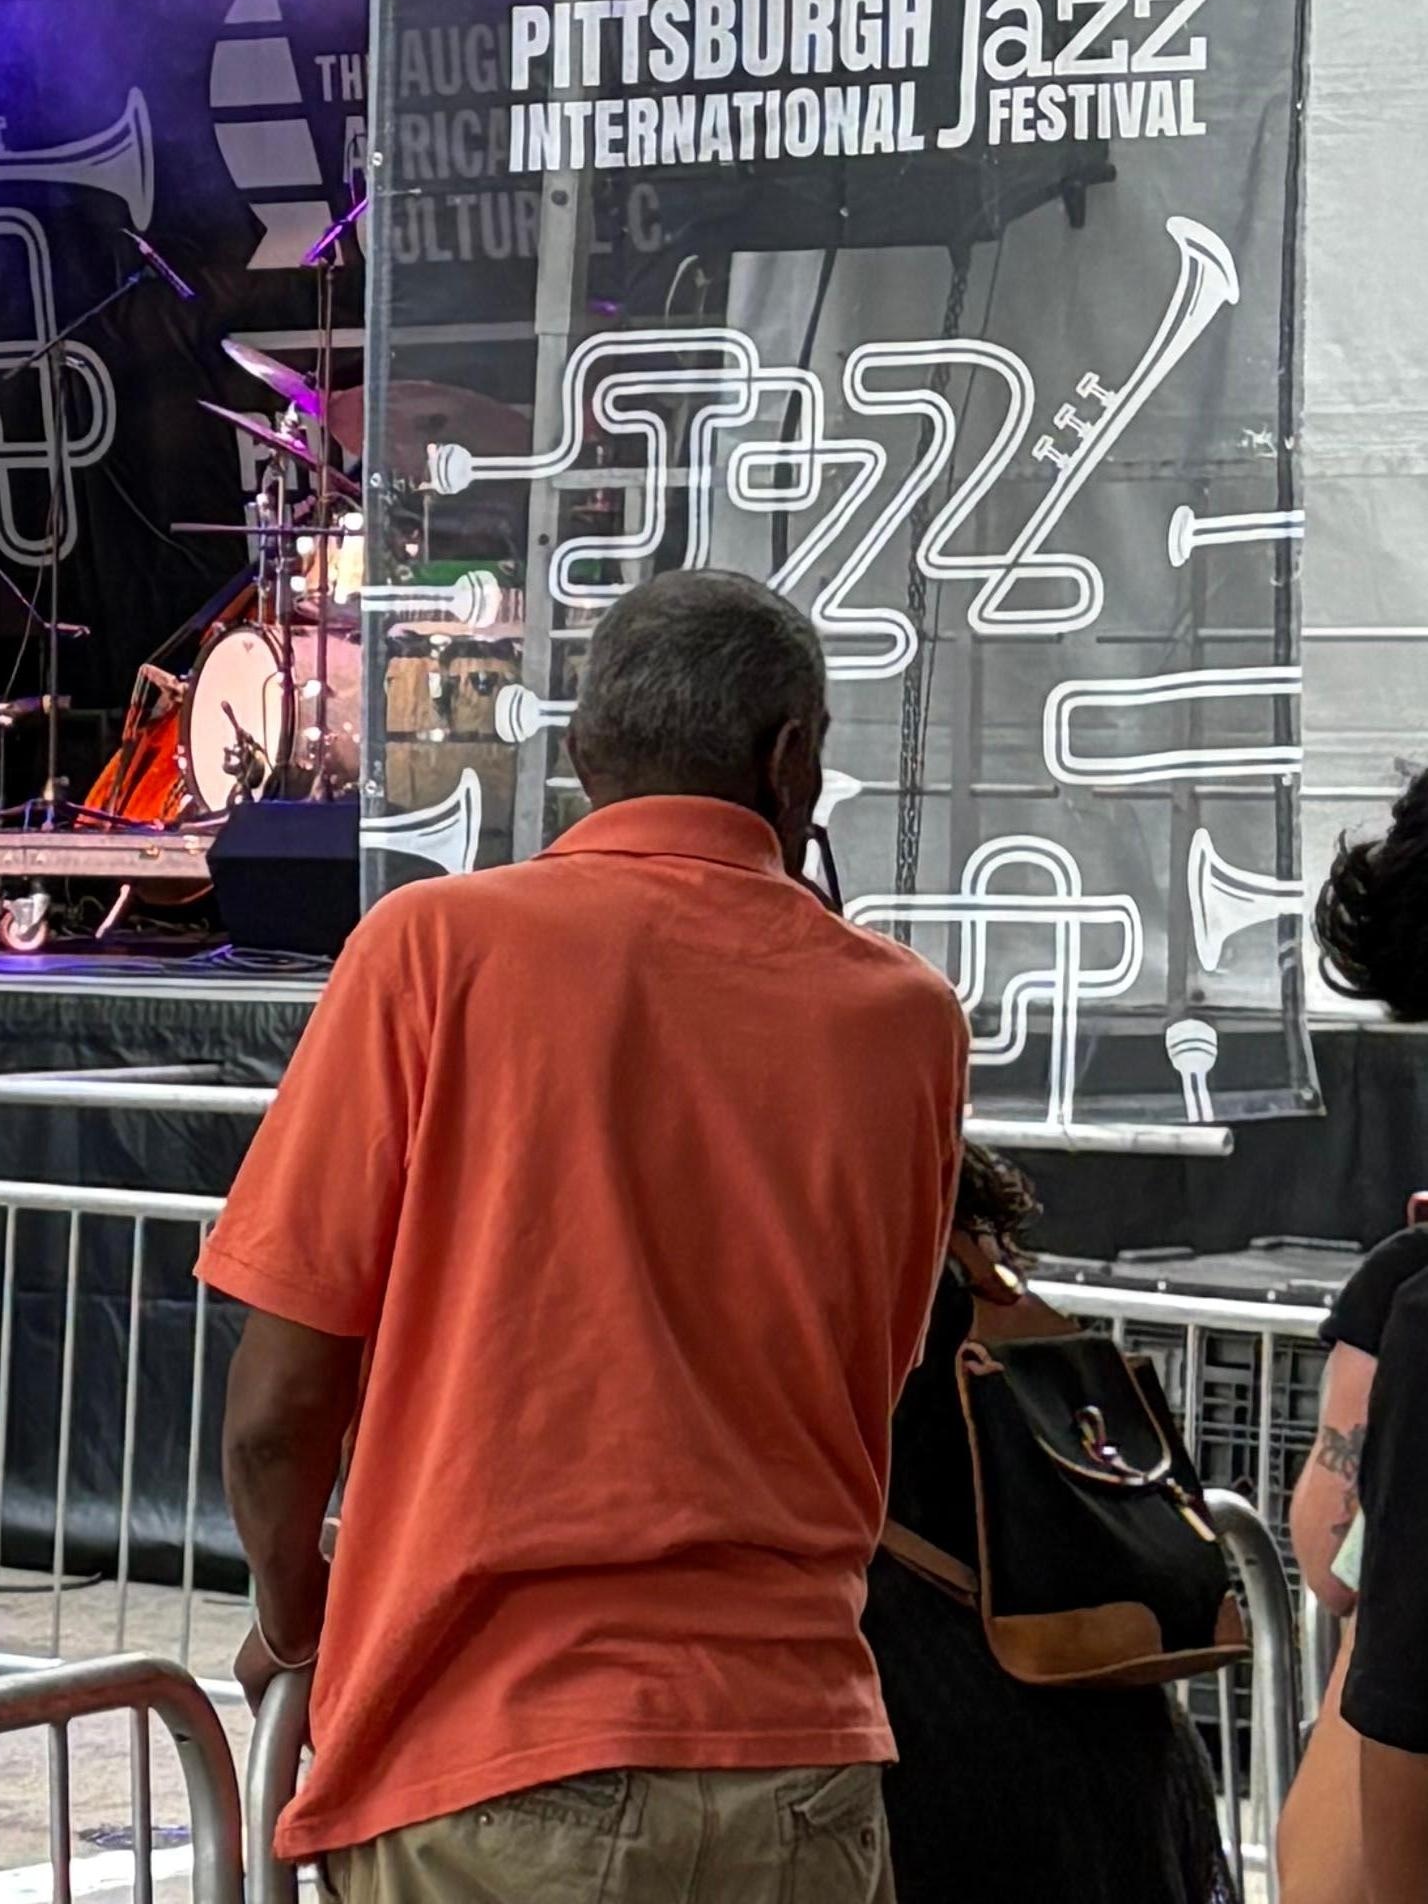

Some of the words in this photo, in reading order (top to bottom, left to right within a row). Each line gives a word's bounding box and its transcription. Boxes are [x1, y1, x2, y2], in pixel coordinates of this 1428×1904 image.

[315, 54, 367, 101] TH
[510, 84, 925, 172] INTERNATIONAL
[987, 81, 1206, 145] FESTIVAL
